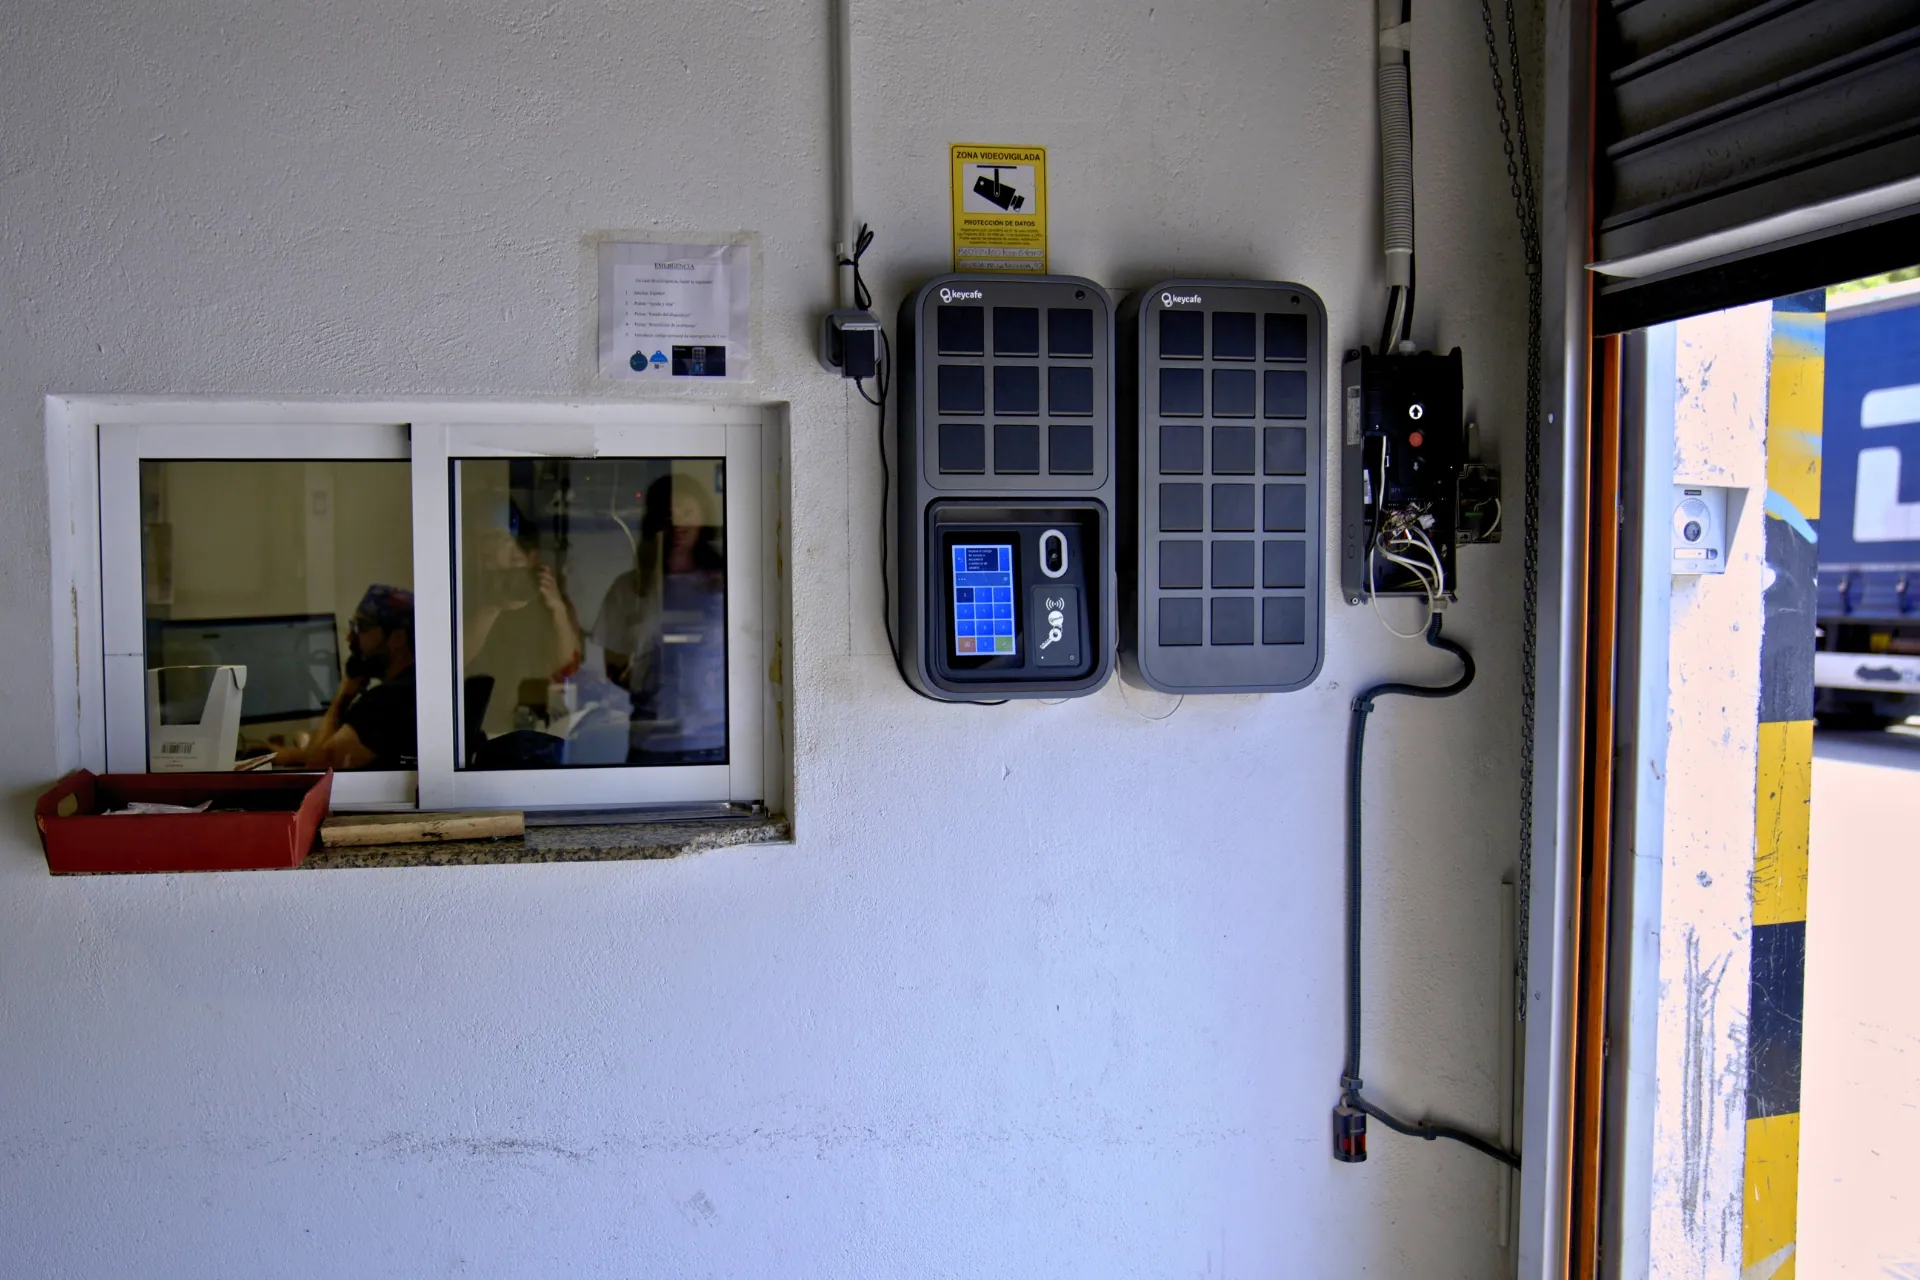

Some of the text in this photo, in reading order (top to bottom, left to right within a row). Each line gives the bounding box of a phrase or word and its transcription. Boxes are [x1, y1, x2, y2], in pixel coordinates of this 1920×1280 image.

[956, 151, 1041, 161] ZONA VIDEOVIGILADA
[654, 262, 695, 270] EMERGENCIA
[951, 289, 983, 301] keycafe
[1172, 293, 1202, 305] keycafe
